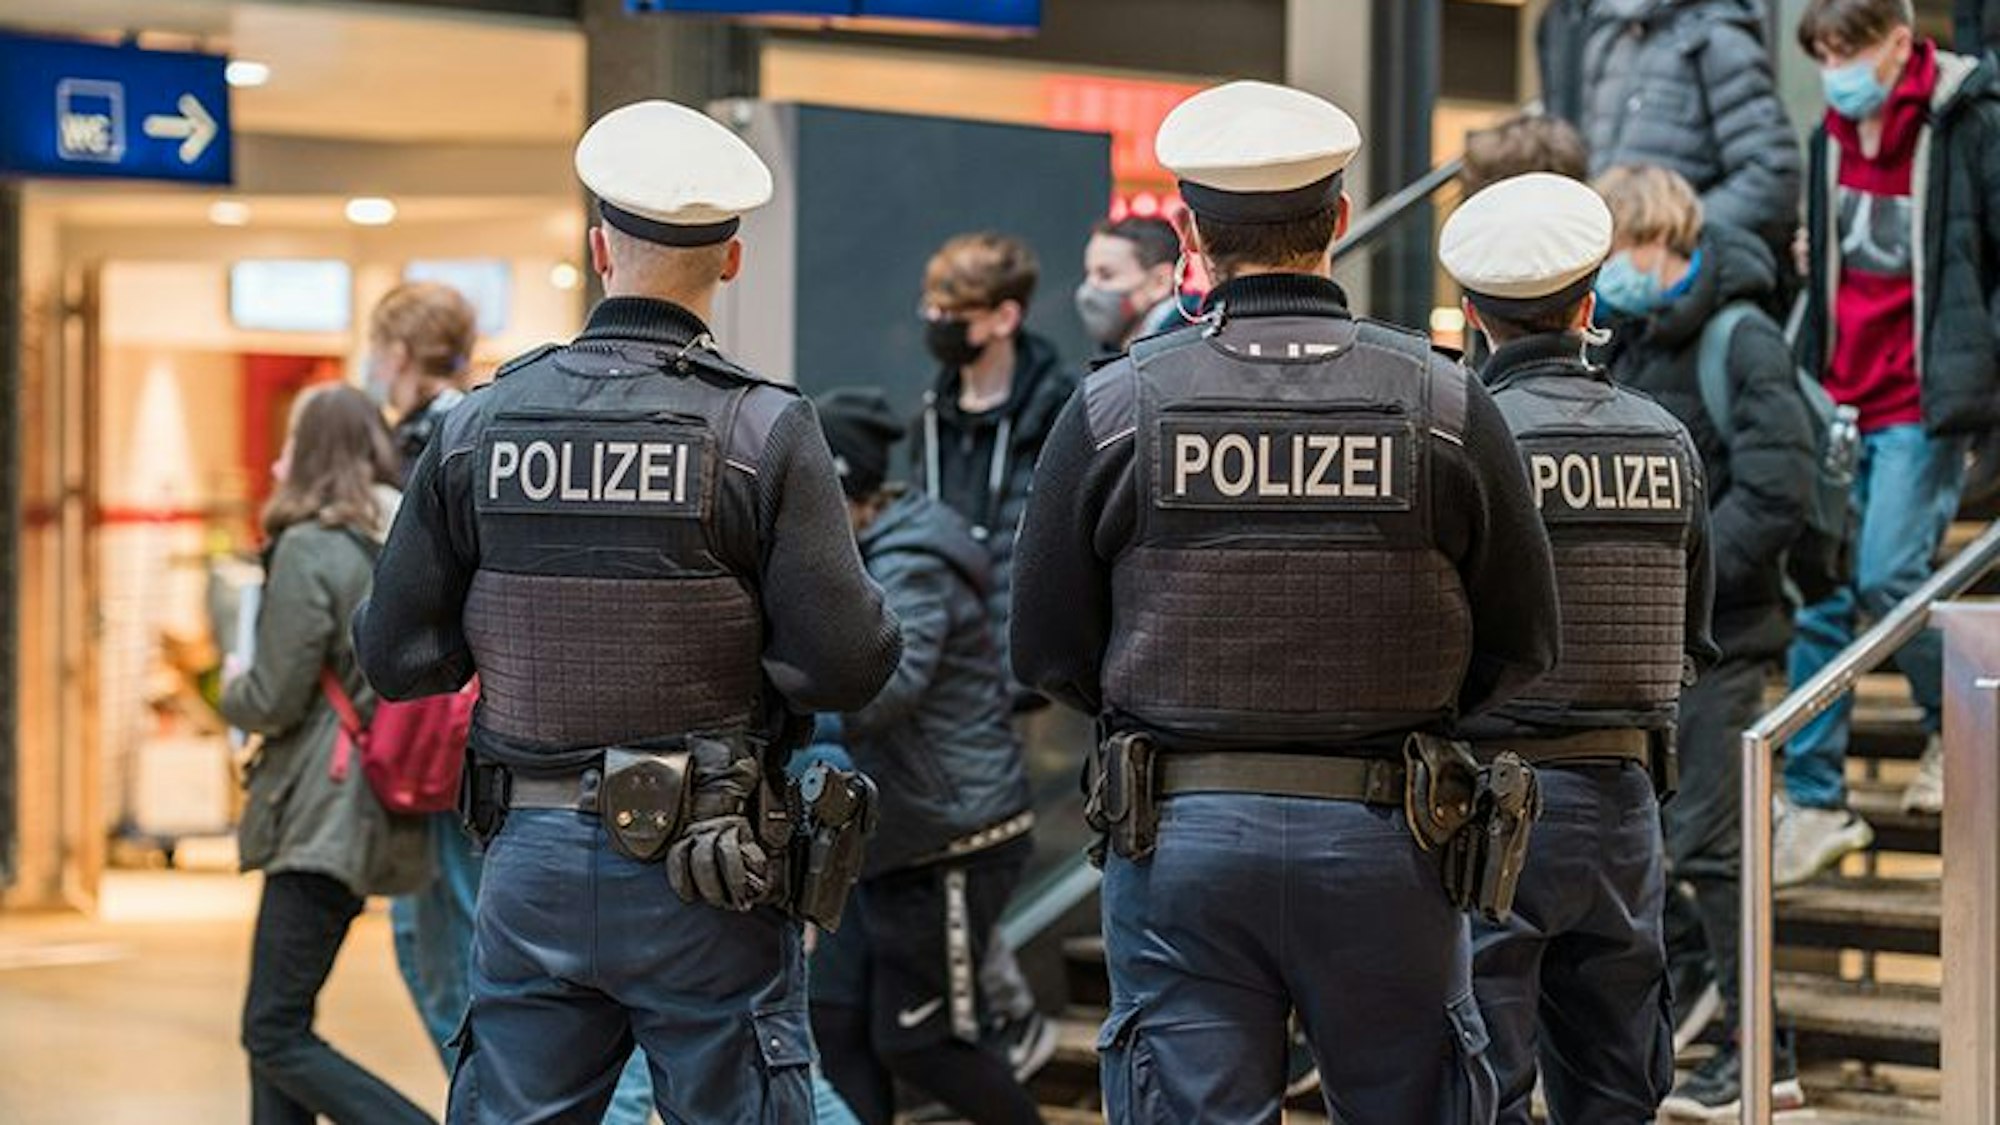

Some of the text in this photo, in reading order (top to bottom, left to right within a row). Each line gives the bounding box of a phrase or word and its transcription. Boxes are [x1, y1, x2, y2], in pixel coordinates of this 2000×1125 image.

[61, 112, 111, 153] WC
[488, 440, 689, 503] POLIZEI
[1174, 433, 1393, 497] POLIZEI
[1530, 453, 1682, 510] POLIZEI
